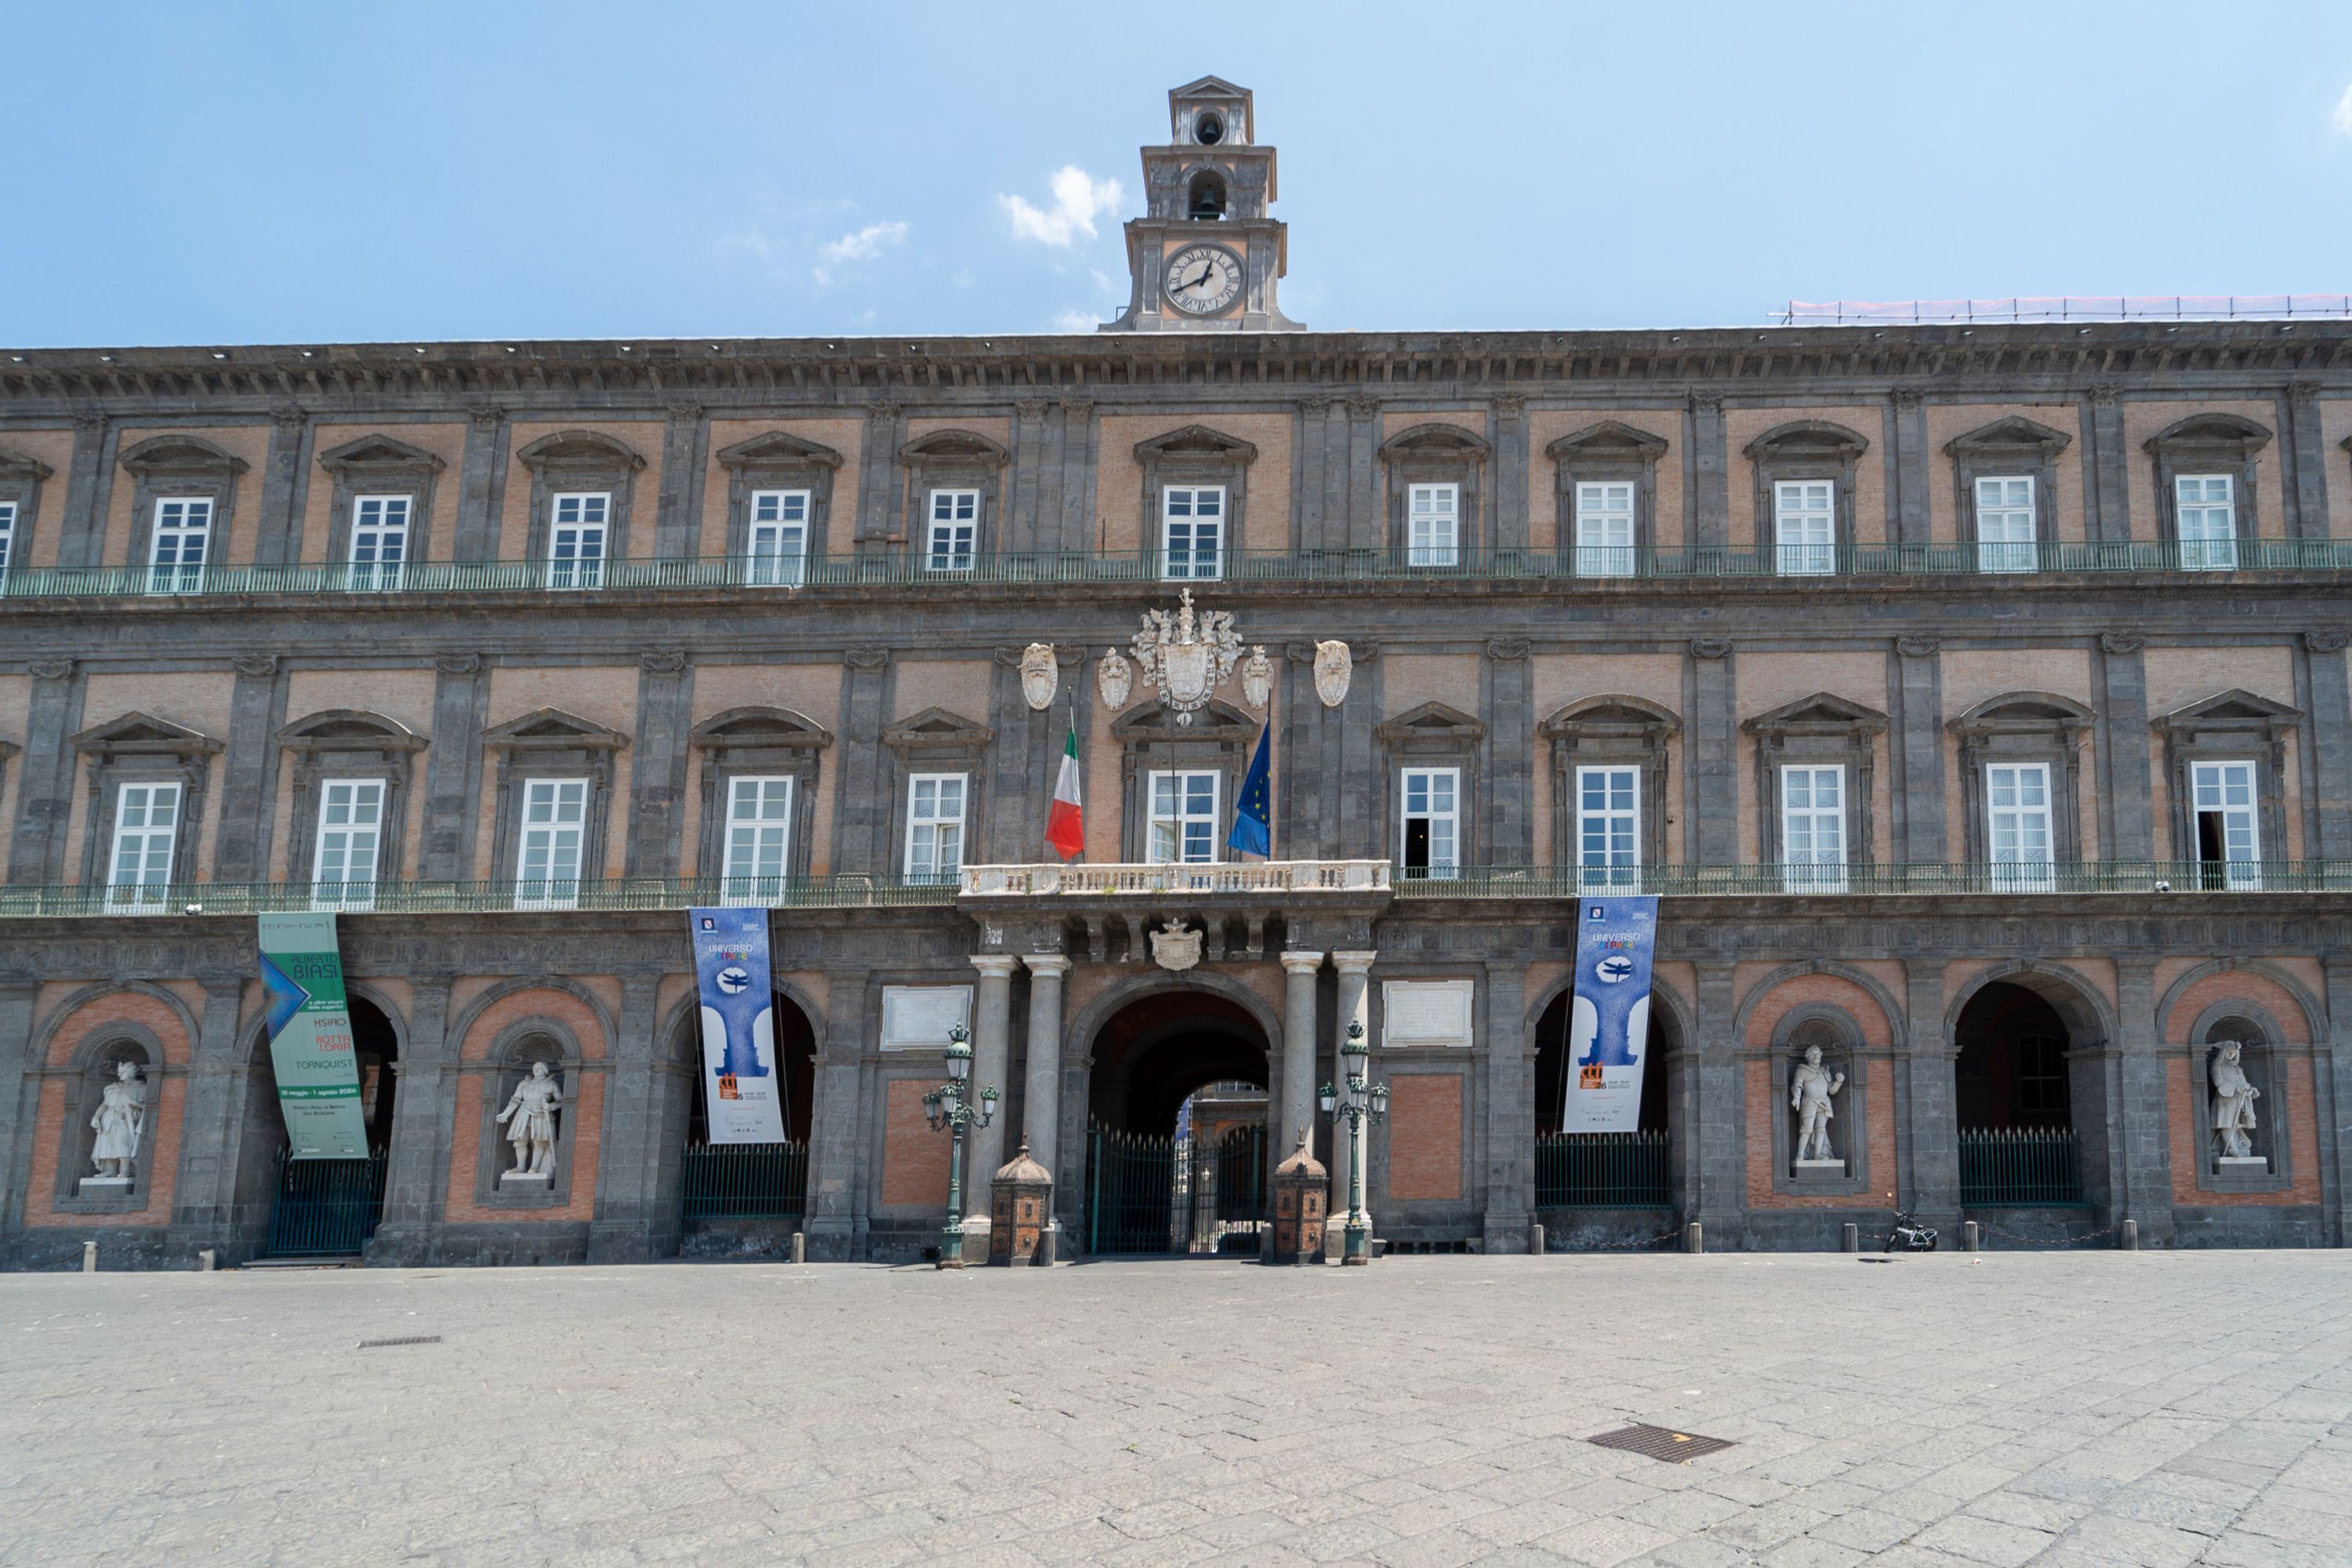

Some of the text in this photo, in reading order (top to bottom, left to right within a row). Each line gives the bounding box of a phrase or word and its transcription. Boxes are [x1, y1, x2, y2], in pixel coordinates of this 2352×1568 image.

[1593, 933, 1640, 942] UNIVERSO
[709, 944, 753, 953] UNIVERSO
[1610, 940, 1635, 949] PACE
[292, 954, 338, 964] ALBERTO
[293, 964, 338, 979] BIASI
[314, 1018, 347, 1027] HSIAO
[315, 1035, 350, 1044] ROTTA
[319, 1043, 351, 1052] LORIA
[296, 1059, 354, 1069] TORNQUIST
